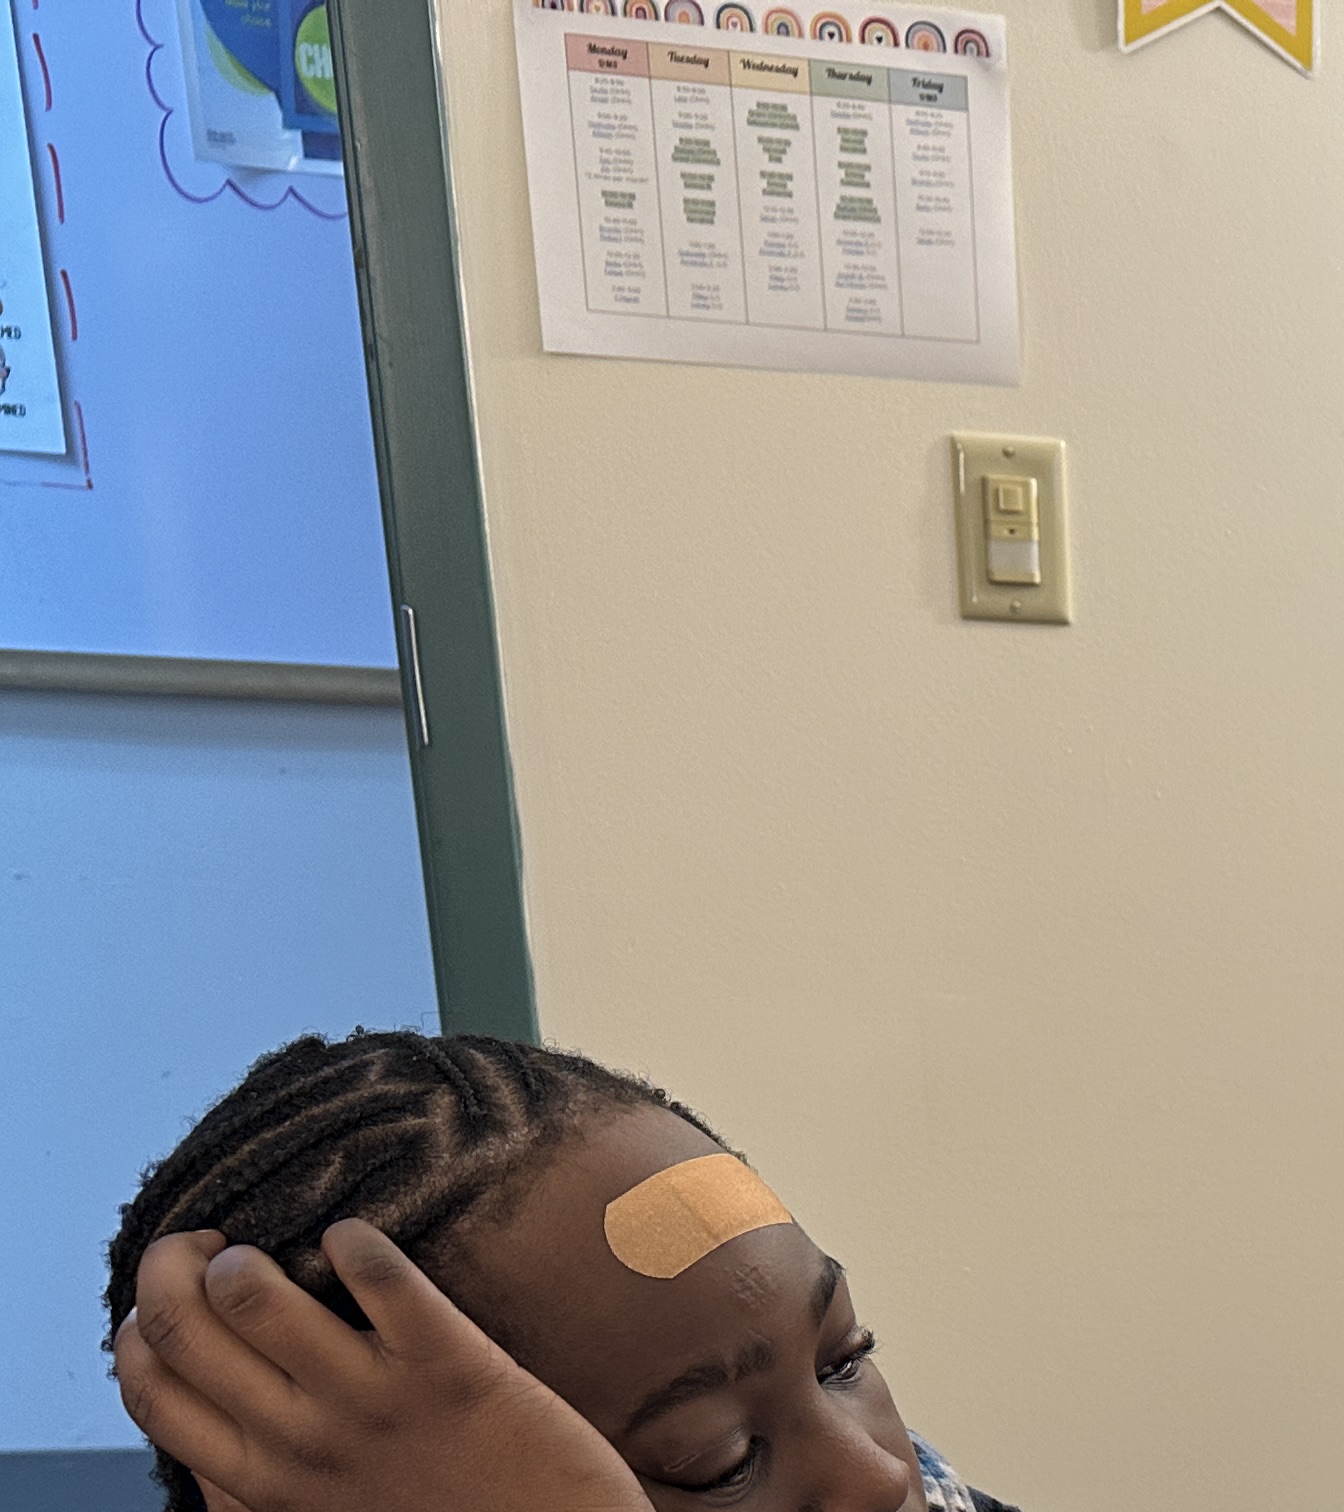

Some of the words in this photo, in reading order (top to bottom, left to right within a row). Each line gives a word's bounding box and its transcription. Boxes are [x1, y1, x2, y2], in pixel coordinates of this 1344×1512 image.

[587, 42, 628, 60] Monday
[667, 50, 710, 69] Tuesday
[739, 58, 799, 78] Wednesday
[825, 67, 873, 86] Thursday
[911, 77, 944, 94] Friday
